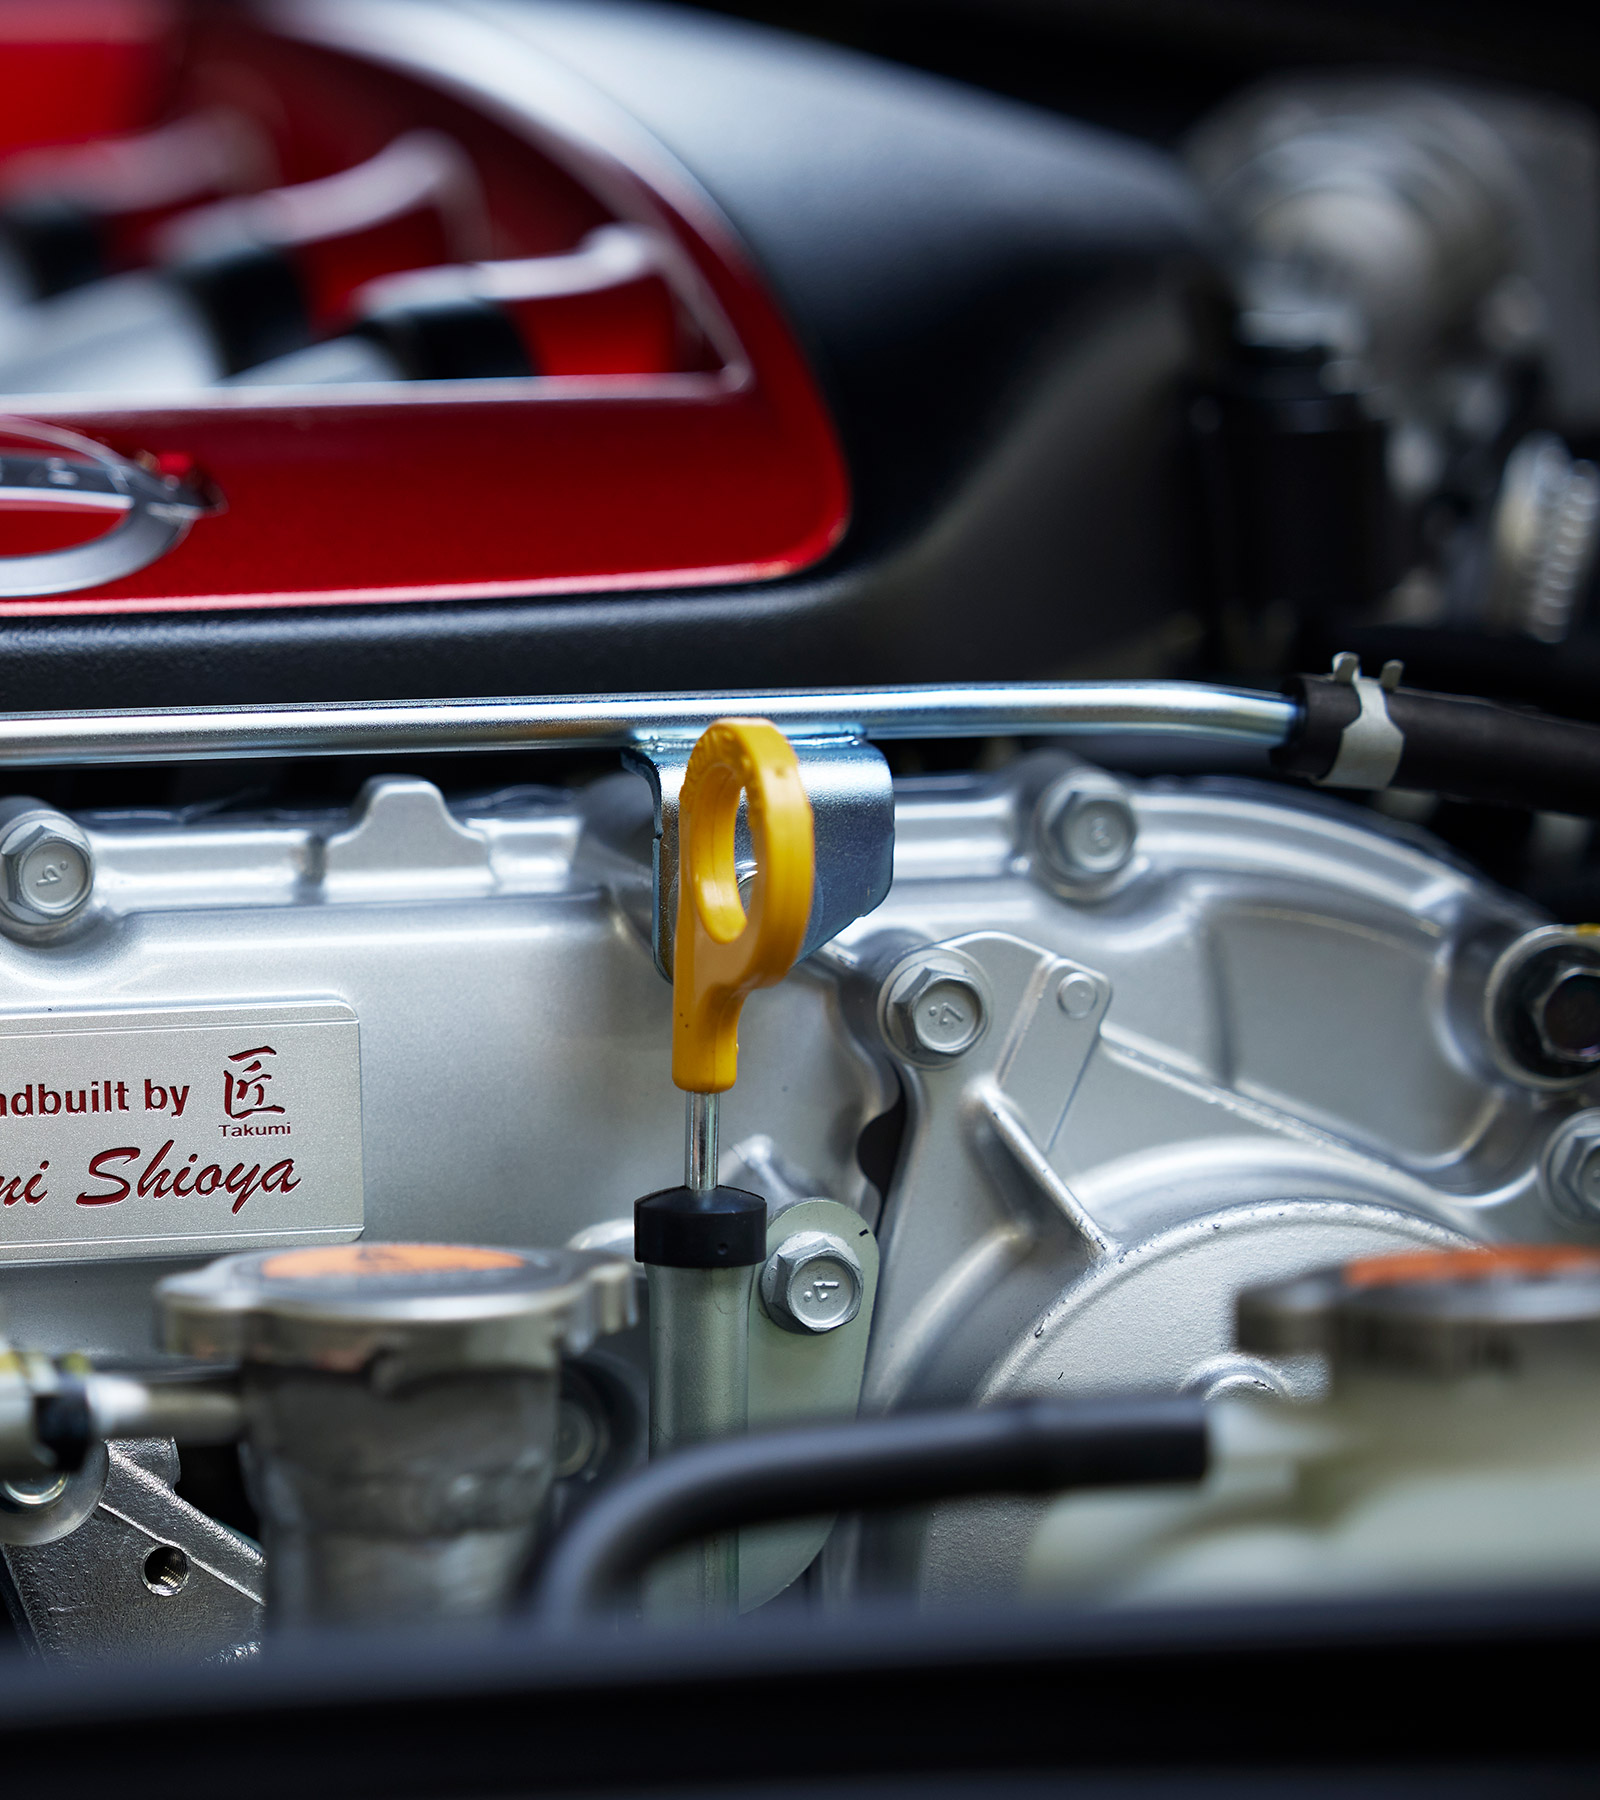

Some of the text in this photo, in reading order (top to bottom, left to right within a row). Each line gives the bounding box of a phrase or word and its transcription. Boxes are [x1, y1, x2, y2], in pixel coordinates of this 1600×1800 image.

[144, 1078, 190, 1118] by
[223, 1045, 286, 1120] 匠
[218, 1121, 292, 1138] Takumi
[75, 1139, 302, 1215] Shioya
